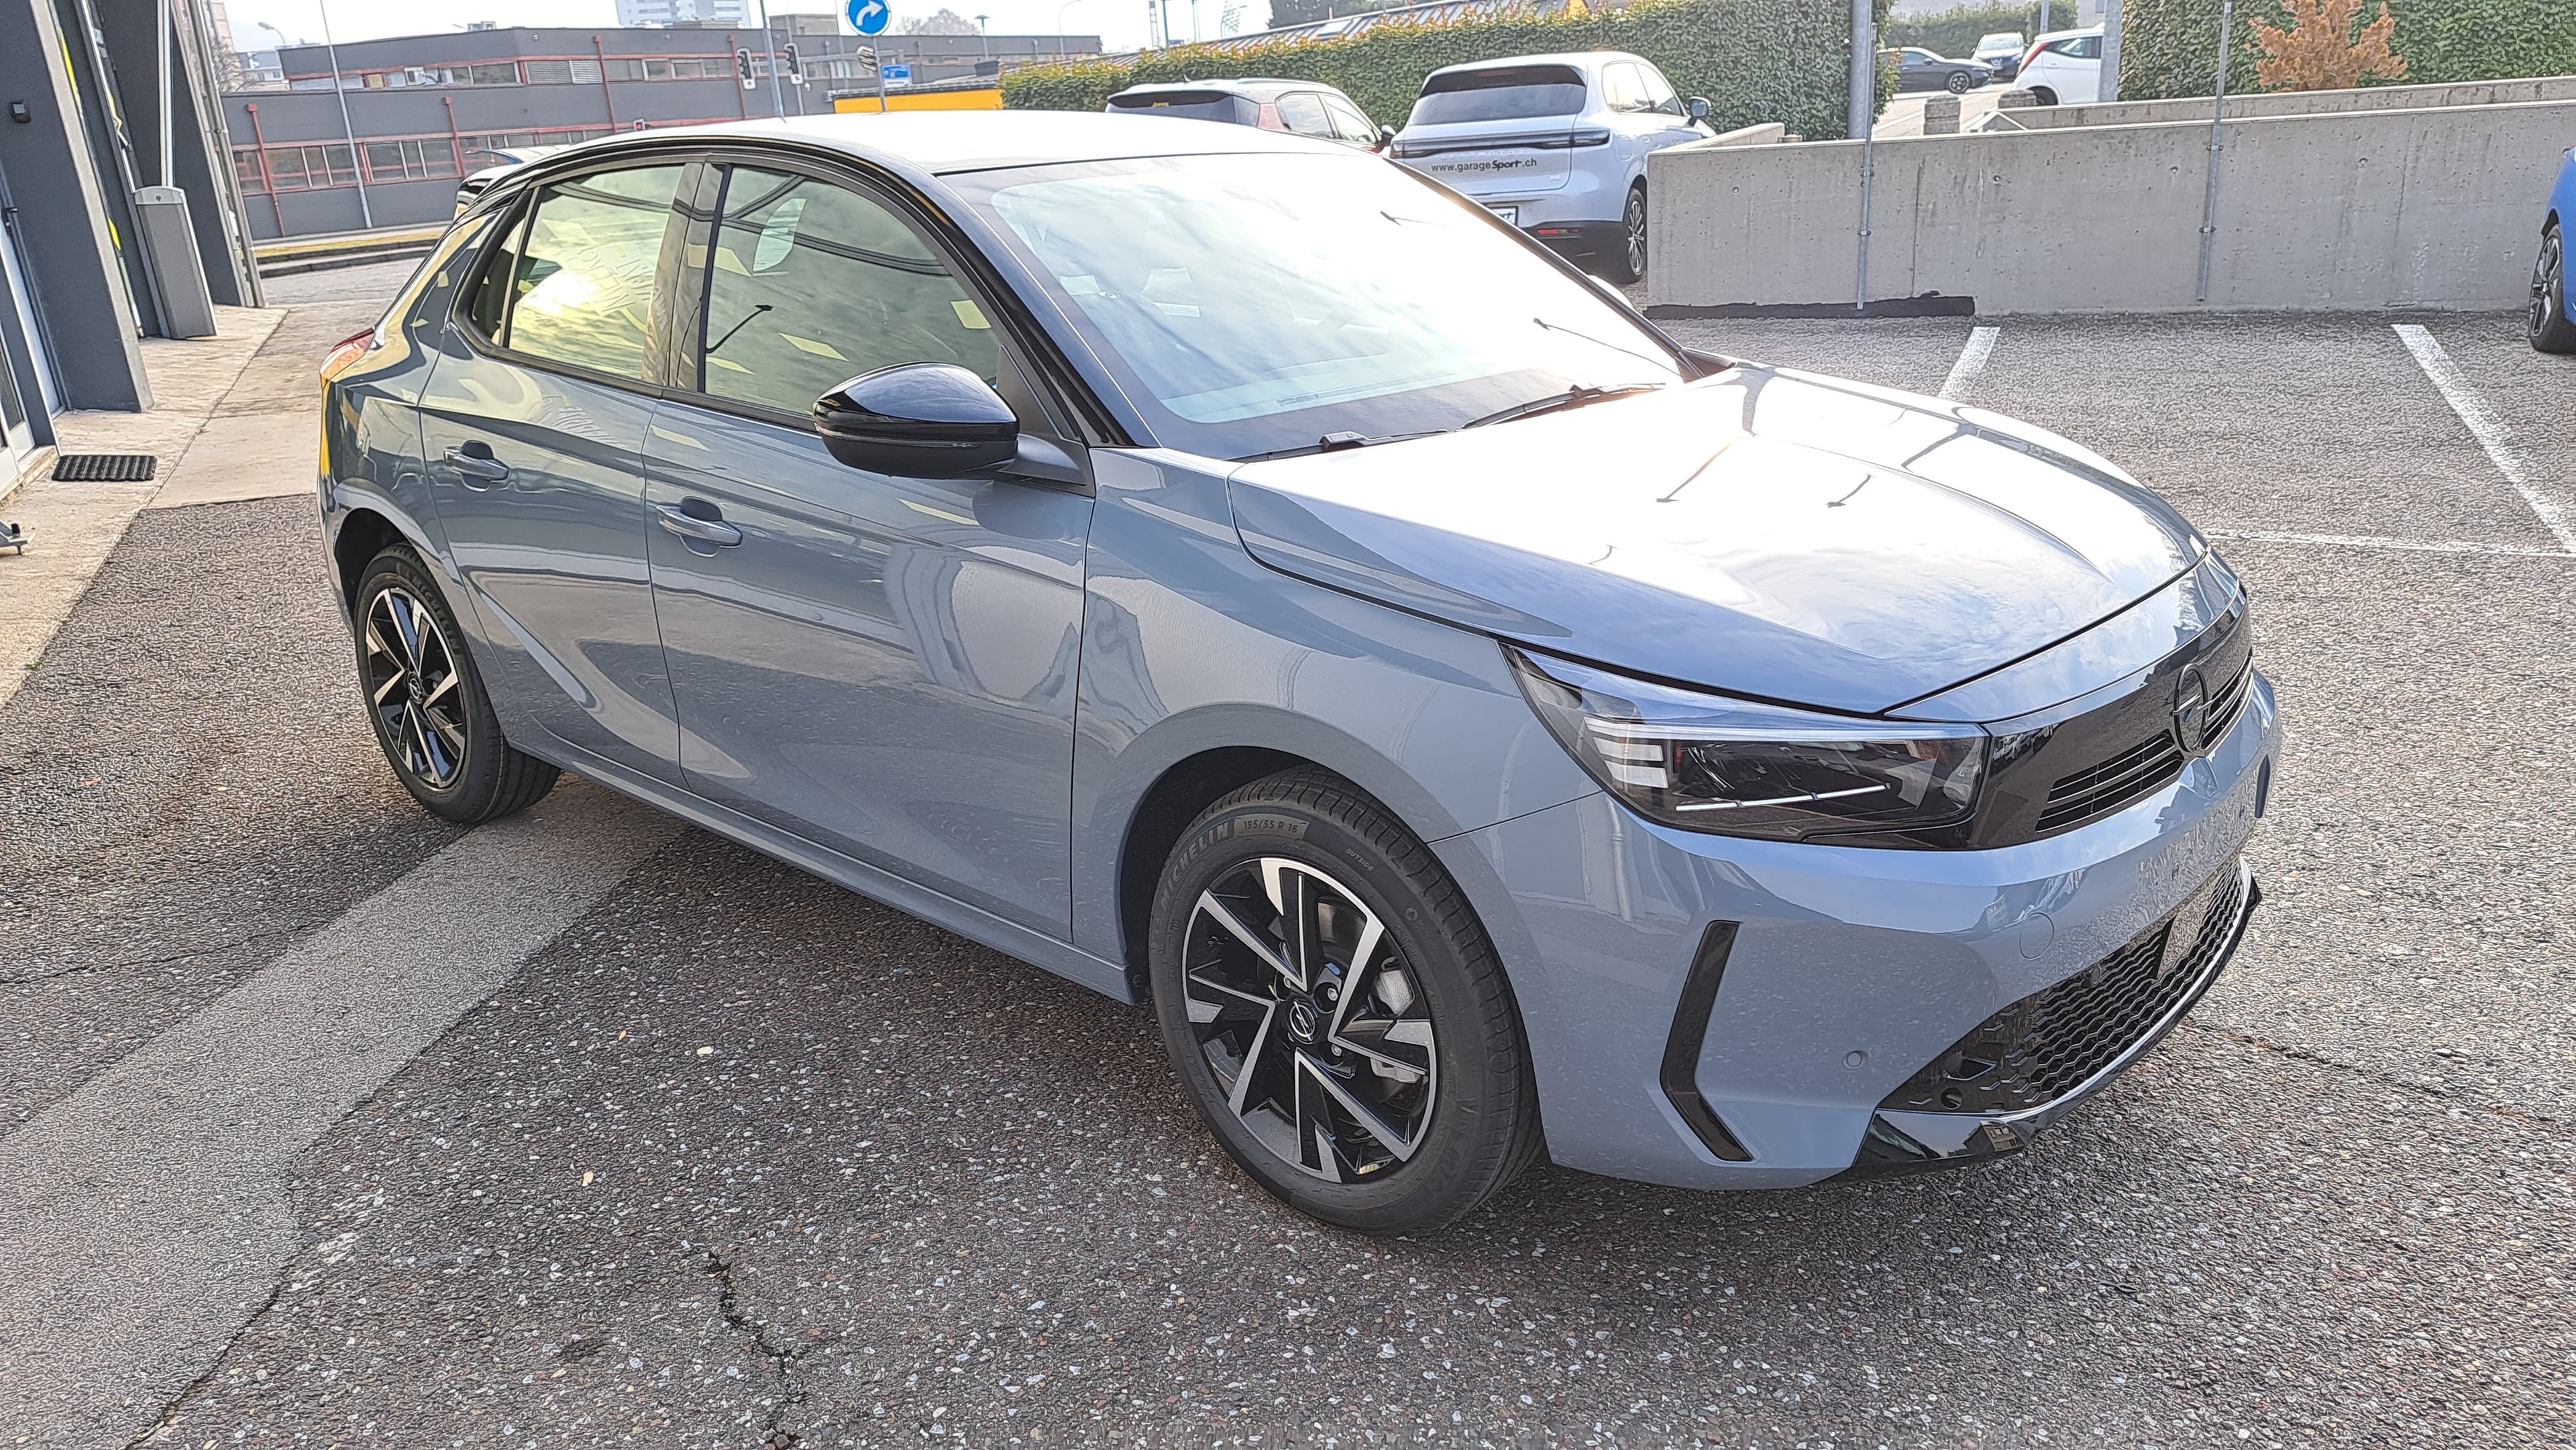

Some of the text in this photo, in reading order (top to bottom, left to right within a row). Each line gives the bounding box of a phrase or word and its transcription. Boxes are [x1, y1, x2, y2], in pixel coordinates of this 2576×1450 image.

[1431, 158, 1538, 173] www.garageSport.ch
[1159, 820, 1299, 911] MICHELIN 195/55 R 16
[1345, 848, 1375, 872] OUTSIDE
